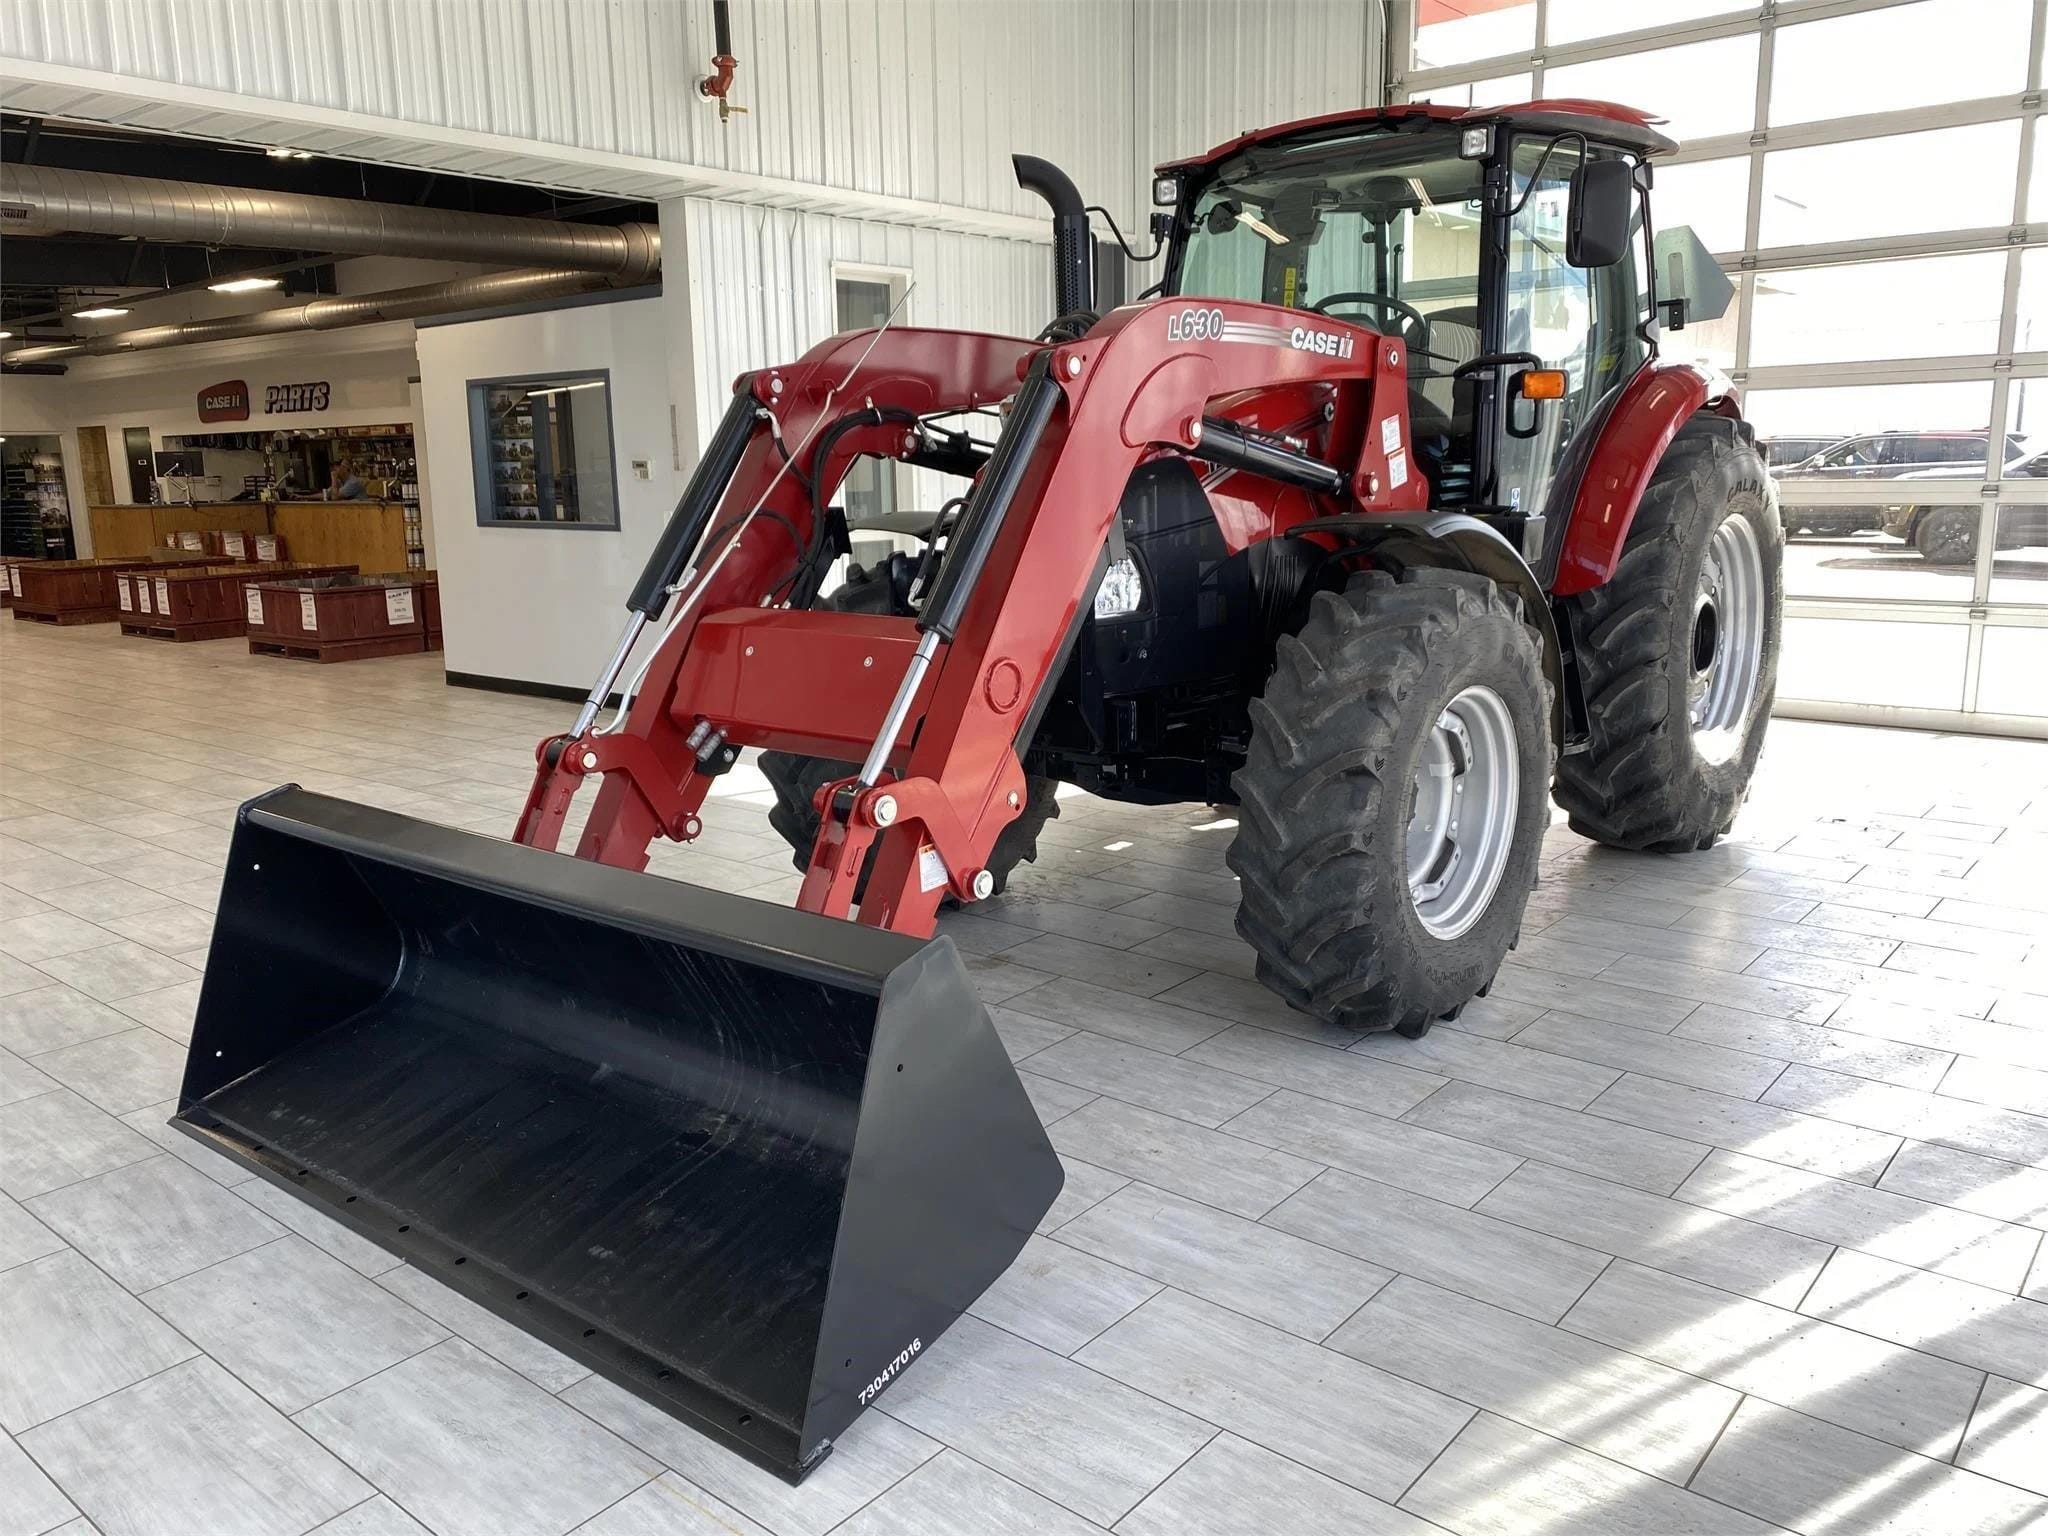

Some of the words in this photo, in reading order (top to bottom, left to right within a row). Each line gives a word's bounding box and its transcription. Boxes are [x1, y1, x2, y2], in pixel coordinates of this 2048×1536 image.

[1168, 309, 1224, 341] L630
[1290, 327, 1339, 357] CASE
[205, 395, 231, 410] CASE
[264, 381, 330, 414] PARTS
[857, 1337, 922, 1406] 730417016
